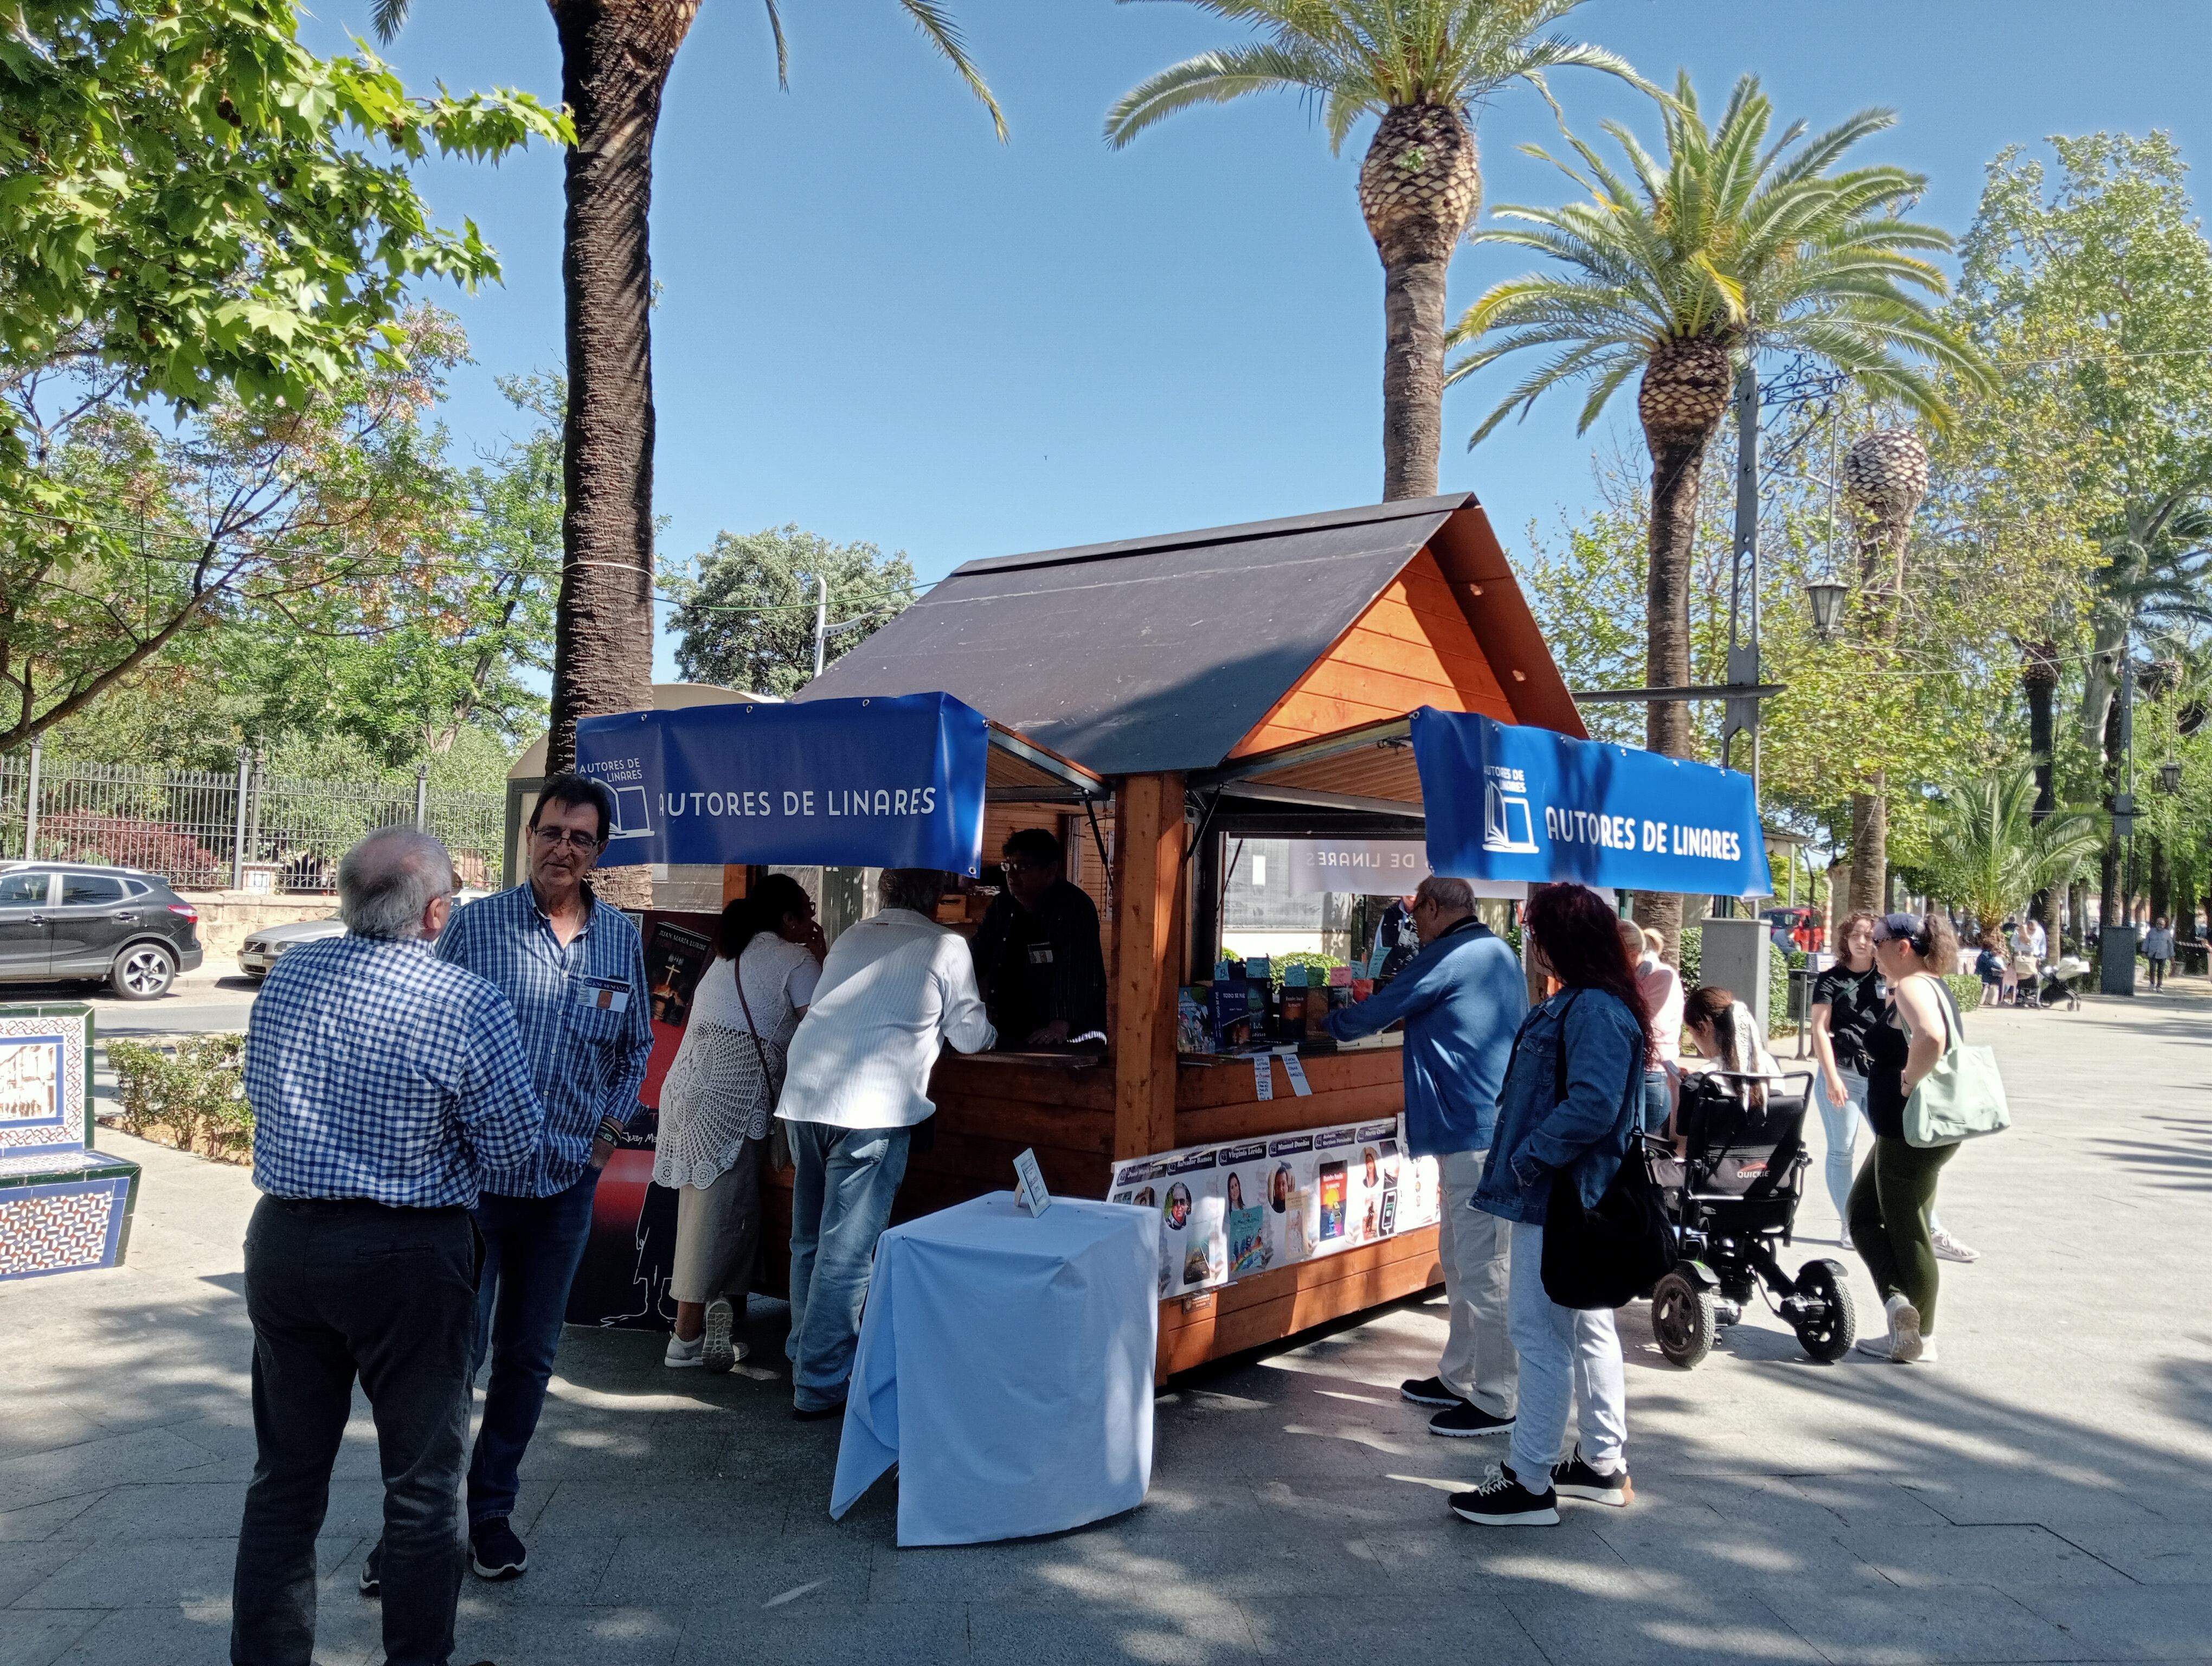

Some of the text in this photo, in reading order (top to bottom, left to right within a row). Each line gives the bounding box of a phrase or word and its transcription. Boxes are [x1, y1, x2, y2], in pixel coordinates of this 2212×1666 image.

[579, 758, 641, 774] AUTORES DE
[607, 770, 642, 783] LINARES
[1484, 765, 1525, 781] AUTORES DE
[1499, 779, 1527, 793] LINARES
[659, 787, 936, 817] AUTORES DE LINARES
[1545, 806, 1741, 861] AUTORES DE LINARES
[659, 930, 673, 939] JUAN
[621, 1132, 643, 1145] Juan
[1197, 1156, 1212, 1164] Ramos
[1737, 1170, 1770, 1179] QUICKIE
